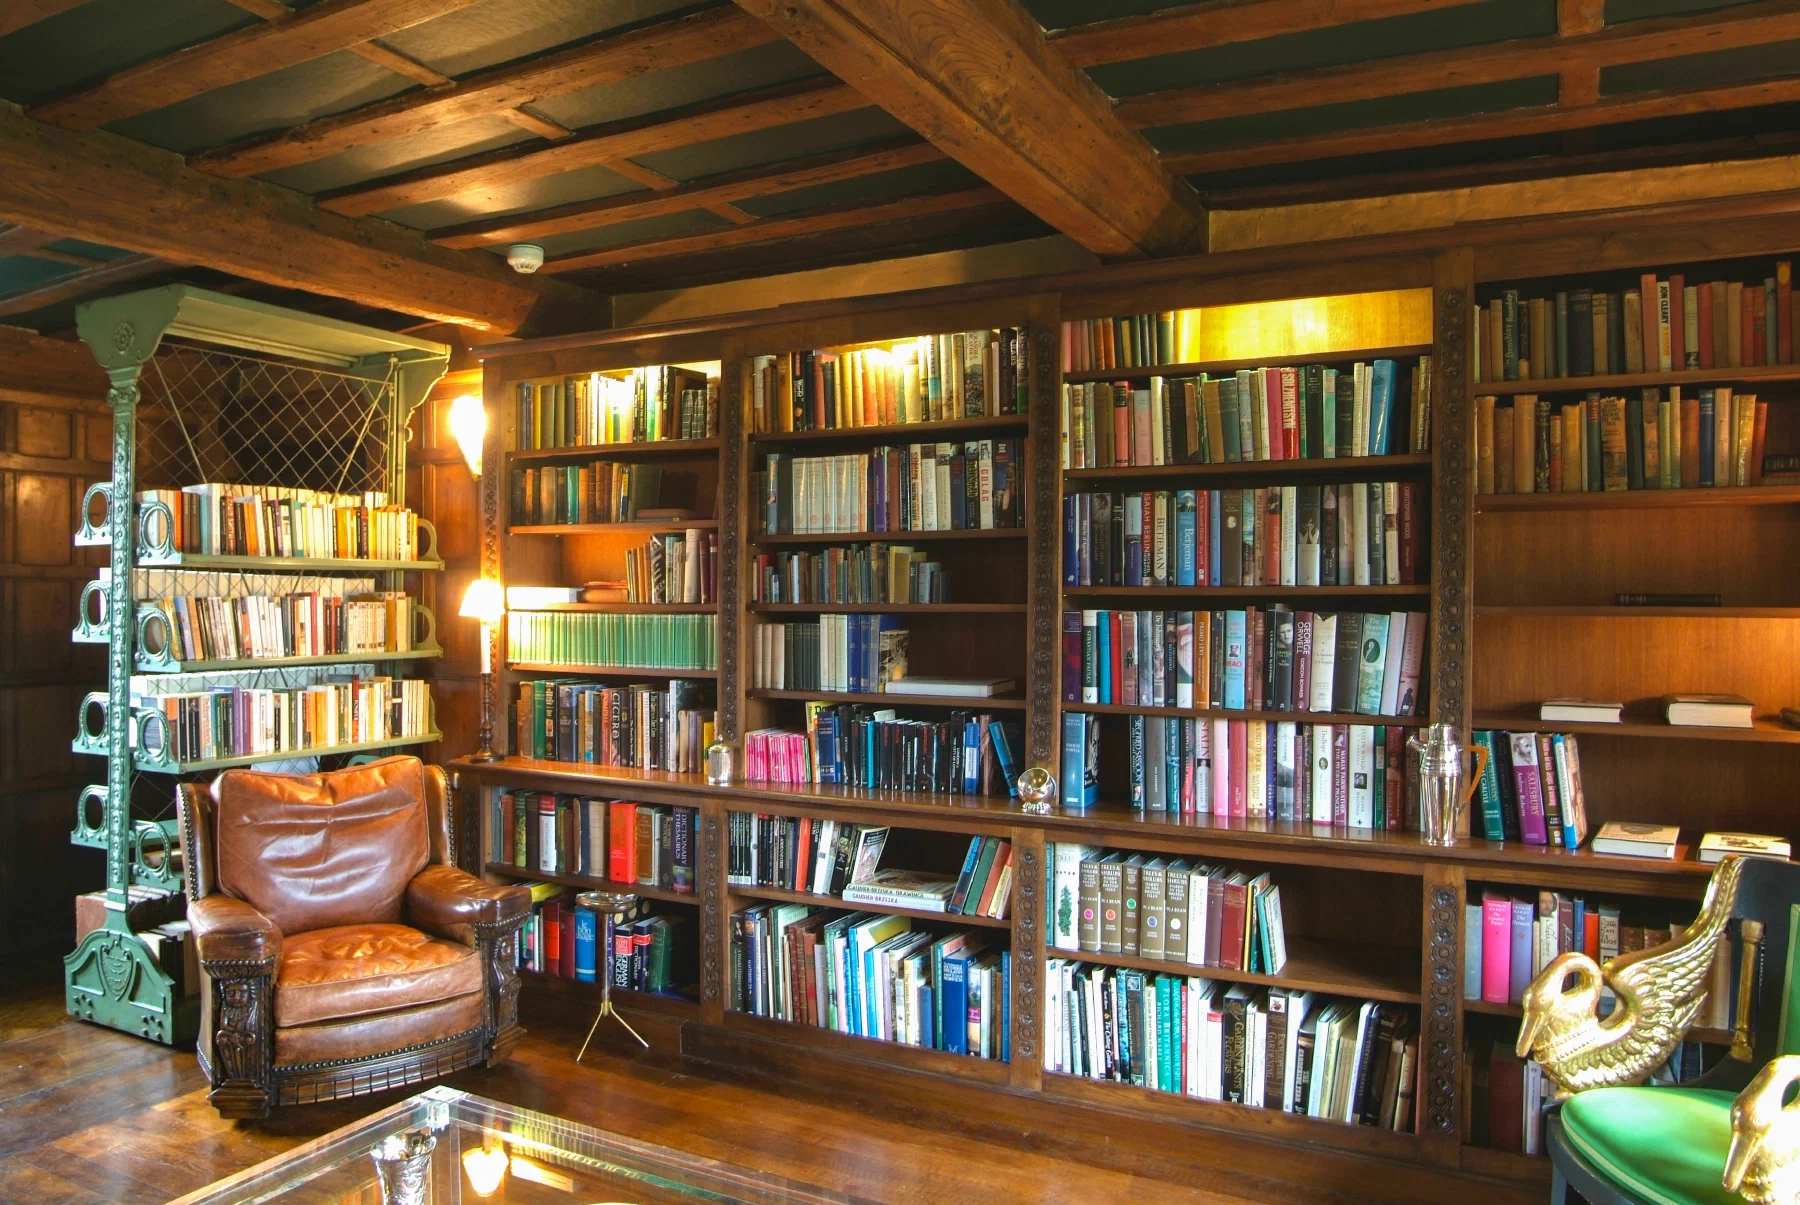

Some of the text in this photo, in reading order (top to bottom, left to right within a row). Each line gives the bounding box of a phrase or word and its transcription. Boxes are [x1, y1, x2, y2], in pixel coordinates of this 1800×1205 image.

[1660, 286, 1668, 298] JON
[1504, 293, 1514, 358] Benchley Roundup
[1660, 300, 1670, 324] CLEARY
[1281, 374, 1296, 429] SOLZHENITSYN
[911, 452, 920, 480] SOMME
[981, 469, 989, 502] GULAG
[1156, 517, 1165, 570] BETJEMAN
[1182, 528, 1194, 571] Betjeman
[1296, 621, 1304, 654] ORWELL
[1303, 621, 1311, 655] GEORGE
[612, 693, 620, 738] CICERO
[1134, 720, 1143, 782] SIEGFRIED SASSOON
[1201, 720, 1210, 758] STALIN
[1480, 777, 1489, 804] CARLYLE
[1516, 771, 1524, 793] Andrew
[1526, 771, 1539, 816] SALISBURY
[895, 890, 924, 898] DRAWINGS
[578, 925, 592, 934] bon
[1104, 1030, 1112, 1049] Cutting
[1162, 988, 1171, 1076] FLORA BRITANNICA
[1106, 1050, 1114, 1068] Garden
[1224, 1035, 1234, 1074] FLOWERS
[1234, 1022, 1244, 1088] GARDEN PLANTS
[1266, 1031, 1276, 1078] GARDENING
